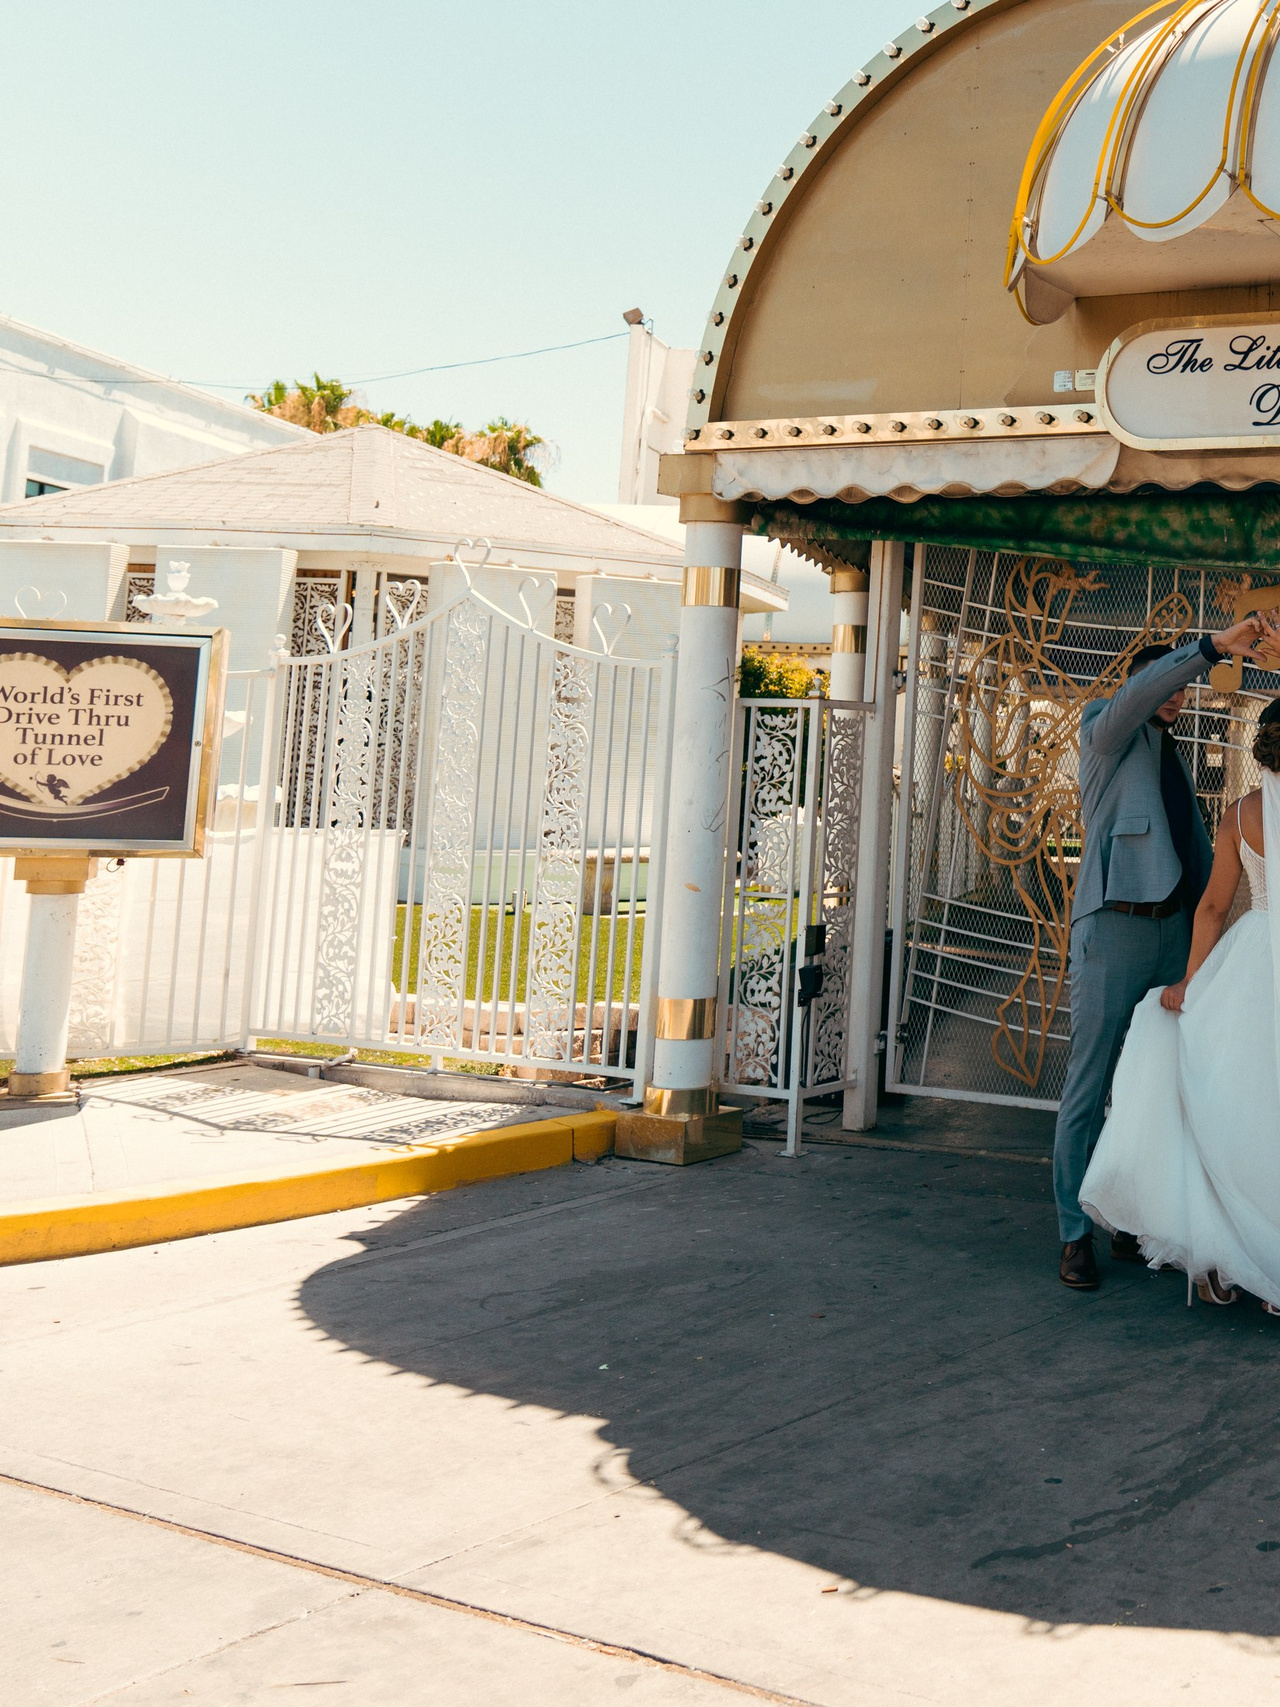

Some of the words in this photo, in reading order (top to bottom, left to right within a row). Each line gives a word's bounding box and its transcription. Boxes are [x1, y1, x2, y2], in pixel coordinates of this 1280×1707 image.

[1147, 338, 1213, 374] The
[88, 688, 144, 707] First
[68, 708, 130, 727] Thru
[15, 727, 105, 746] Tunnel
[13, 747, 42, 765] of
[46, 748, 103, 766] Love
